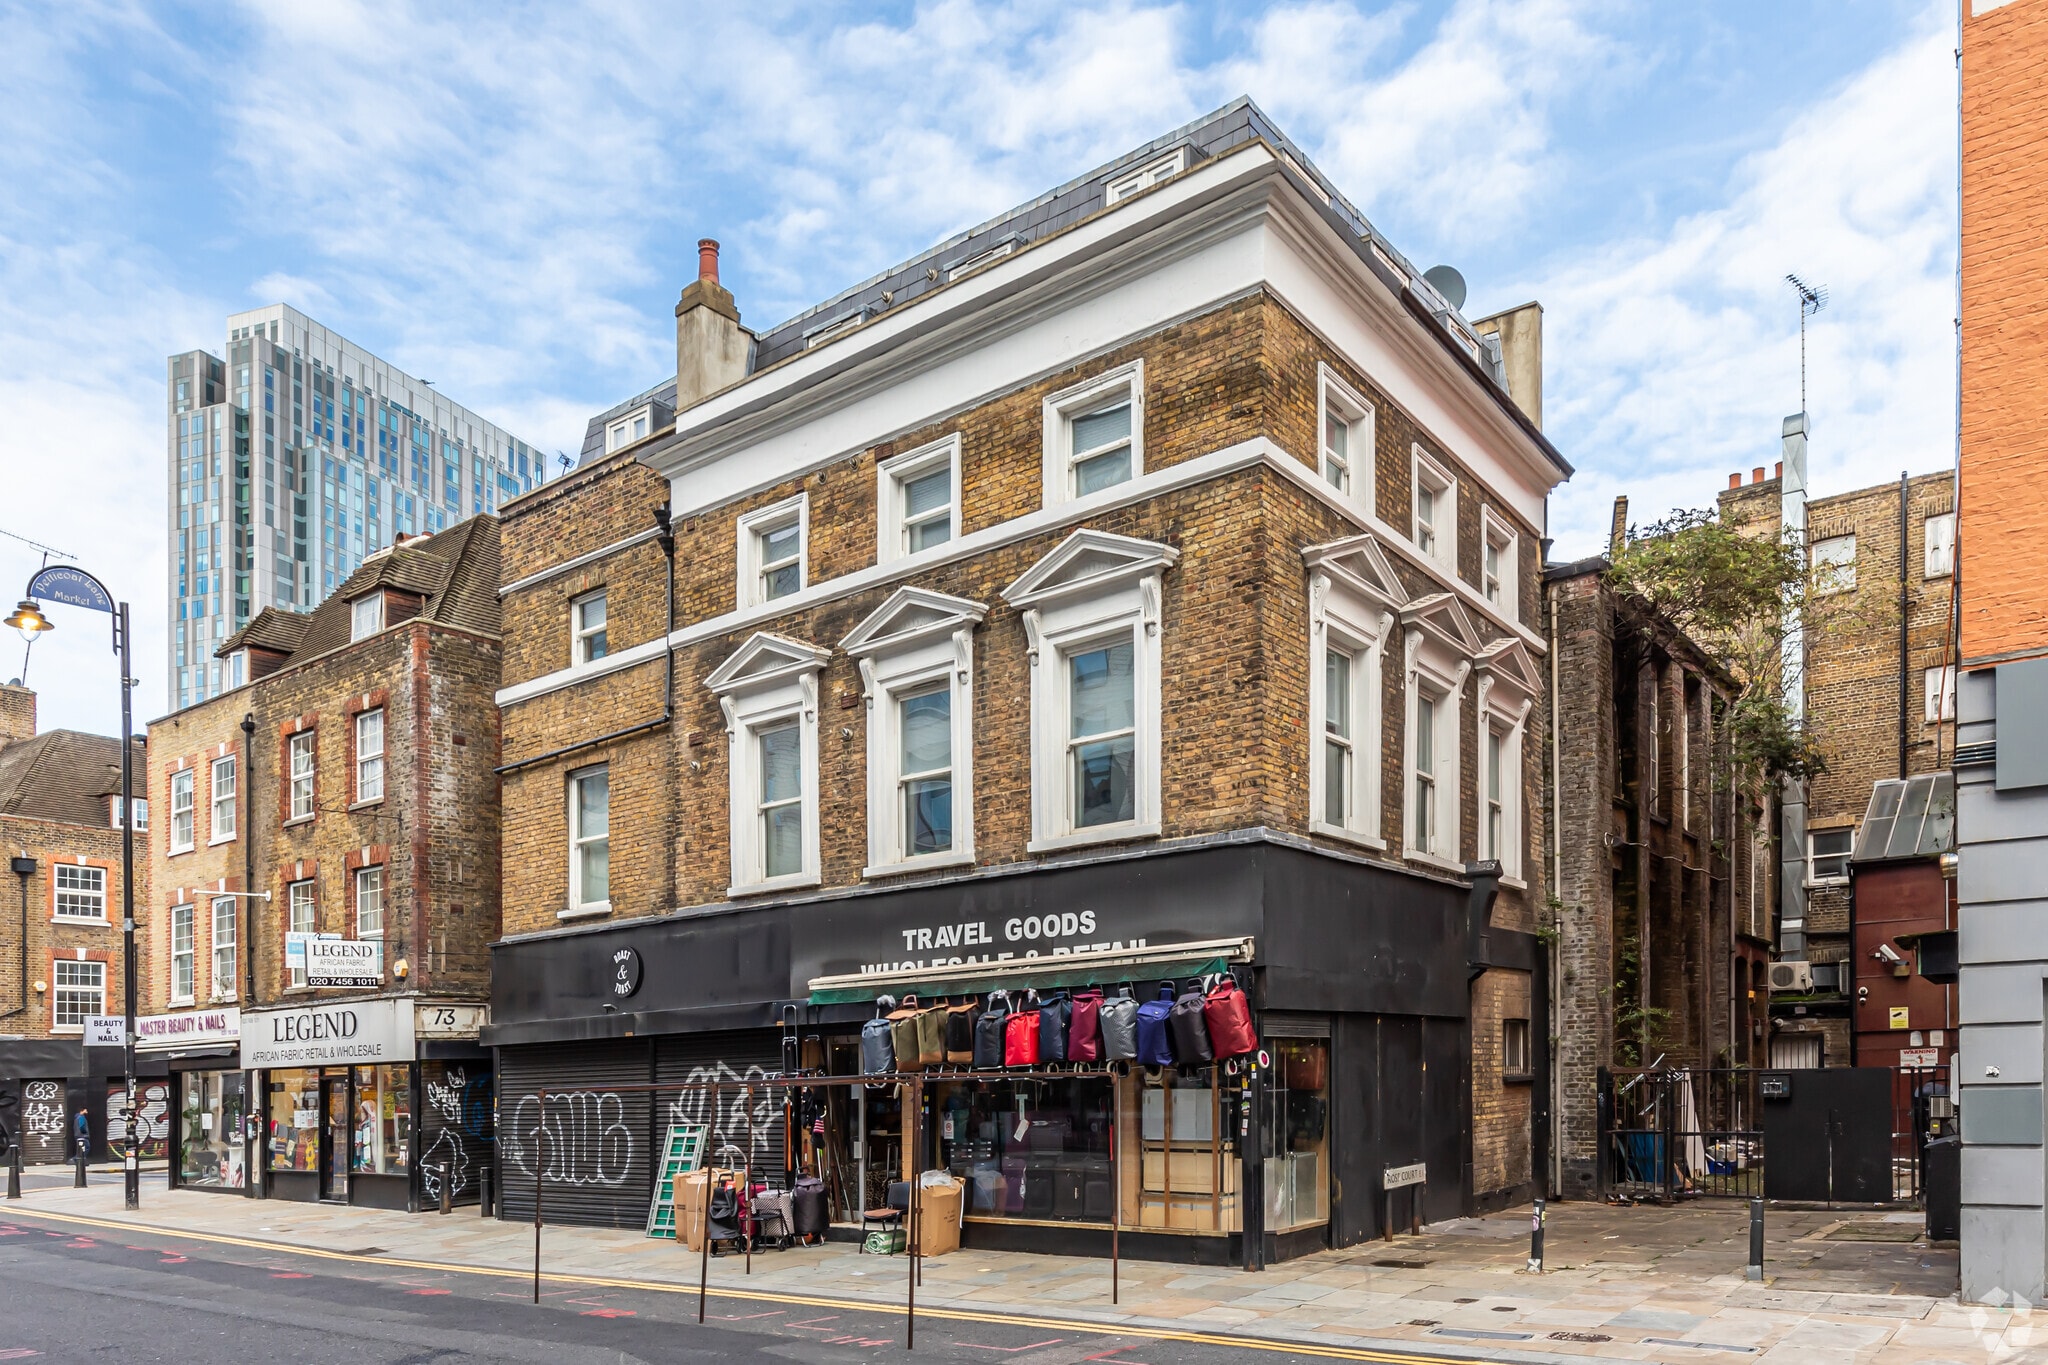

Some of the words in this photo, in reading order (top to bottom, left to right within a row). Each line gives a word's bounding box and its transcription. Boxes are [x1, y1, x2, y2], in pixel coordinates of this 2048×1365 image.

[54, 590, 90, 606] Market
[84, 579, 106, 606] Lane
[902, 921, 993, 951] TRAVEL
[1004, 910, 1097, 942] GOODS
[313, 944, 373, 957] LEGEND
[320, 958, 345, 966] AFRICAN
[346, 959, 366, 967] FABRIC
[312, 967, 332, 976] RETAIL
[339, 968, 373, 976] WHOLESALE
[617, 964, 628, 980] &
[310, 977, 328, 986] 020
[331, 977, 354, 986] 7456
[356, 978, 376, 986] 1011
[93, 1019, 124, 1027] BEAUTY
[434, 1008, 456, 1025] 73
[105, 1027, 111, 1035] &
[140, 1020, 166, 1036] MASTER
[168, 1017, 195, 1033] BEAUTY
[198, 1016, 203, 1031] &
[205, 1014, 226, 1030] NAILS
[273, 1010, 358, 1043] LEGEND
[252, 1050, 280, 1062] AFRICAN
[281, 1048, 304, 1060] FABRIC
[305, 1047, 329, 1060] RETAIL
[330, 1046, 335, 1058] &
[336, 1043, 382, 1058] WHOLESALE
[1401, 1169, 1418, 1181] COURT
